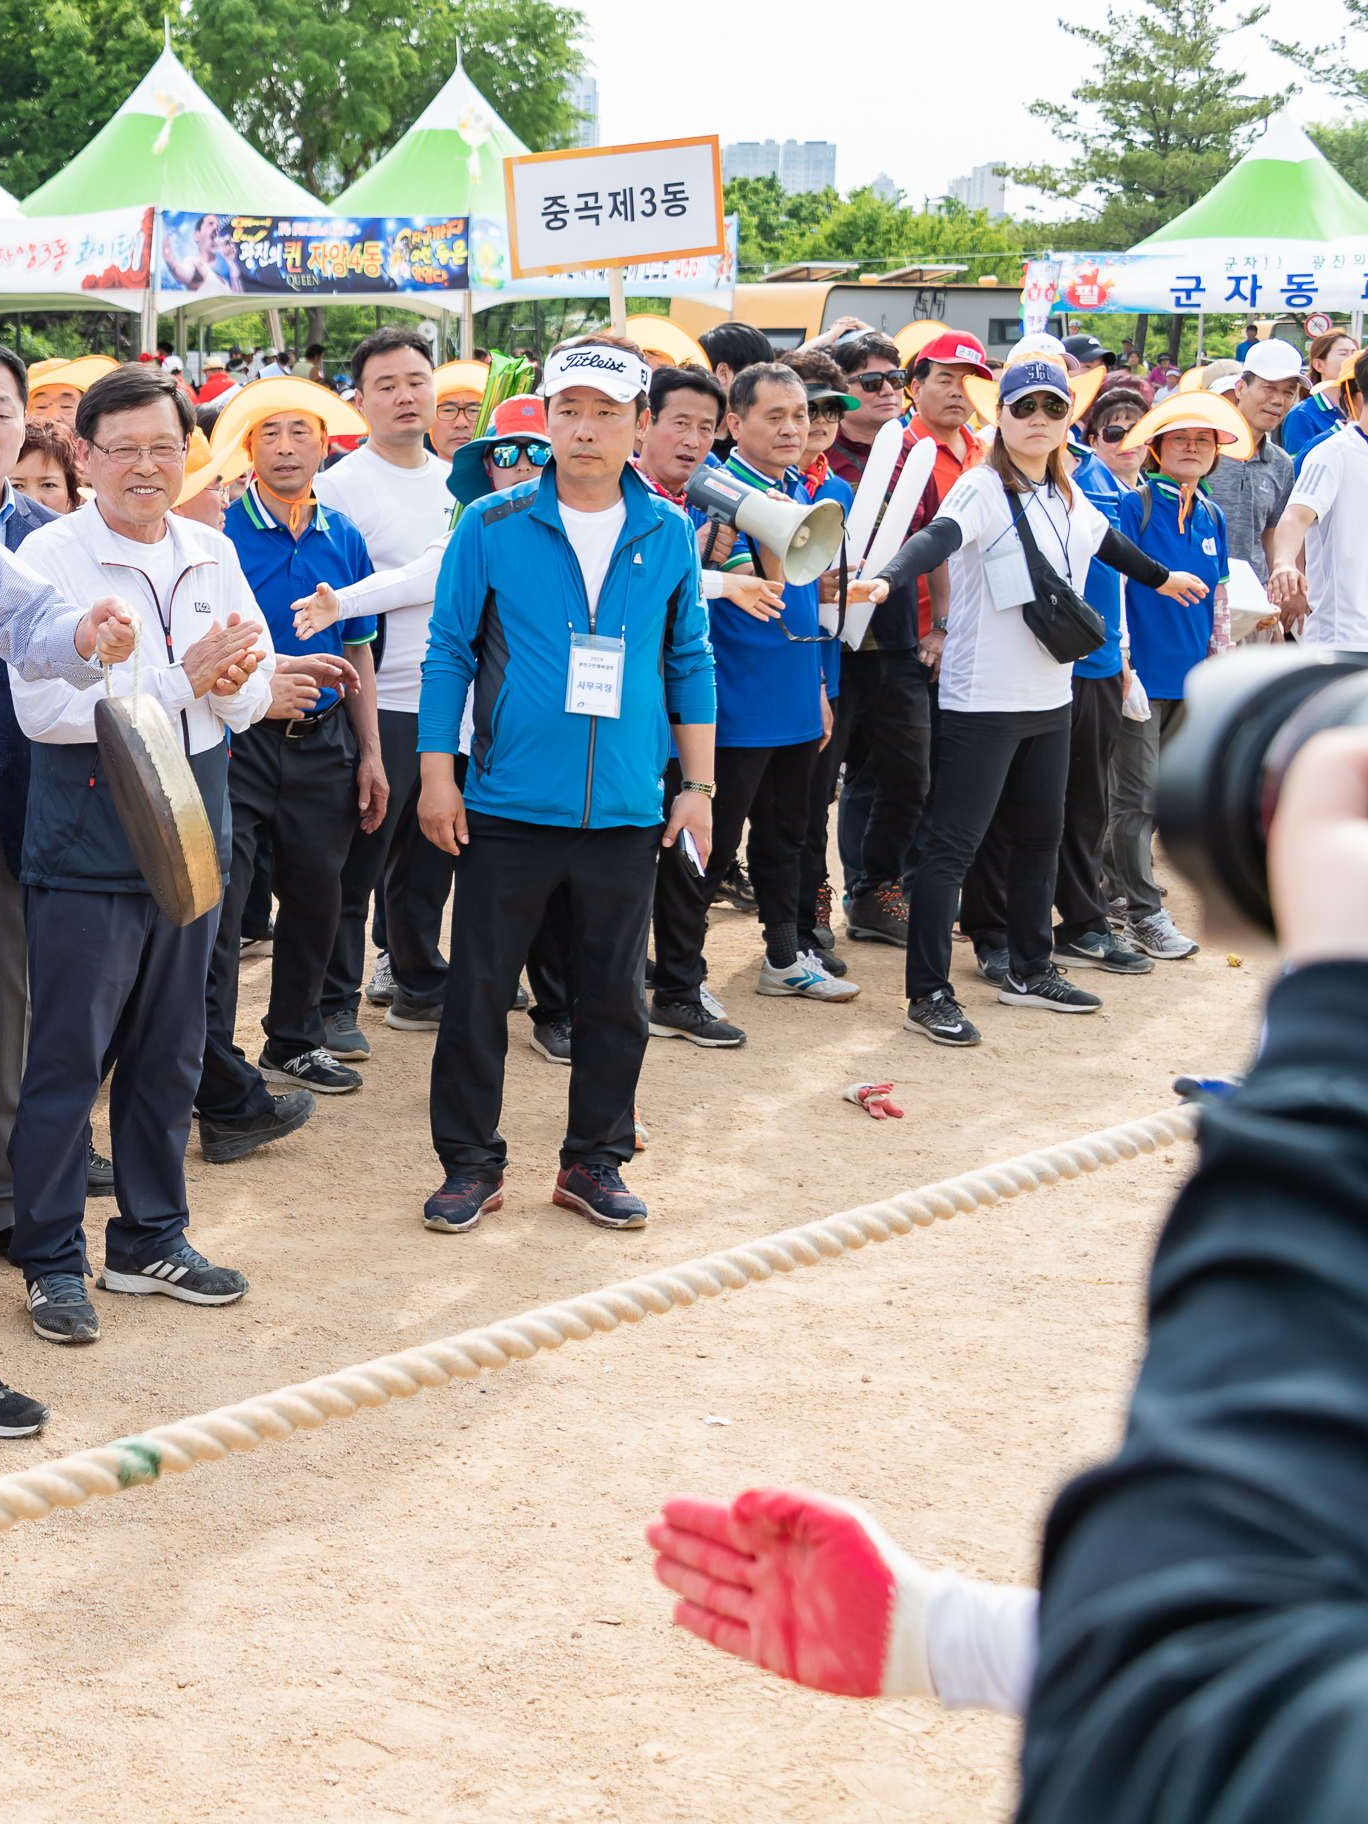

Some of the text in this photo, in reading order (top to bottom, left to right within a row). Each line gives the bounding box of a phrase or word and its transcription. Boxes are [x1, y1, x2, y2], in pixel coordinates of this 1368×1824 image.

[541, 181, 690, 231] 중곡제3동
[239, 240, 384, 279] 광진의 퀸 자양4동
[286, 273, 321, 292] QUEEN
[1169, 273, 1320, 309] 군자동
[1074, 283, 1100, 306] 필
[560, 351, 627, 373] Titleist
[576, 680, 613, 693] 사무국장
